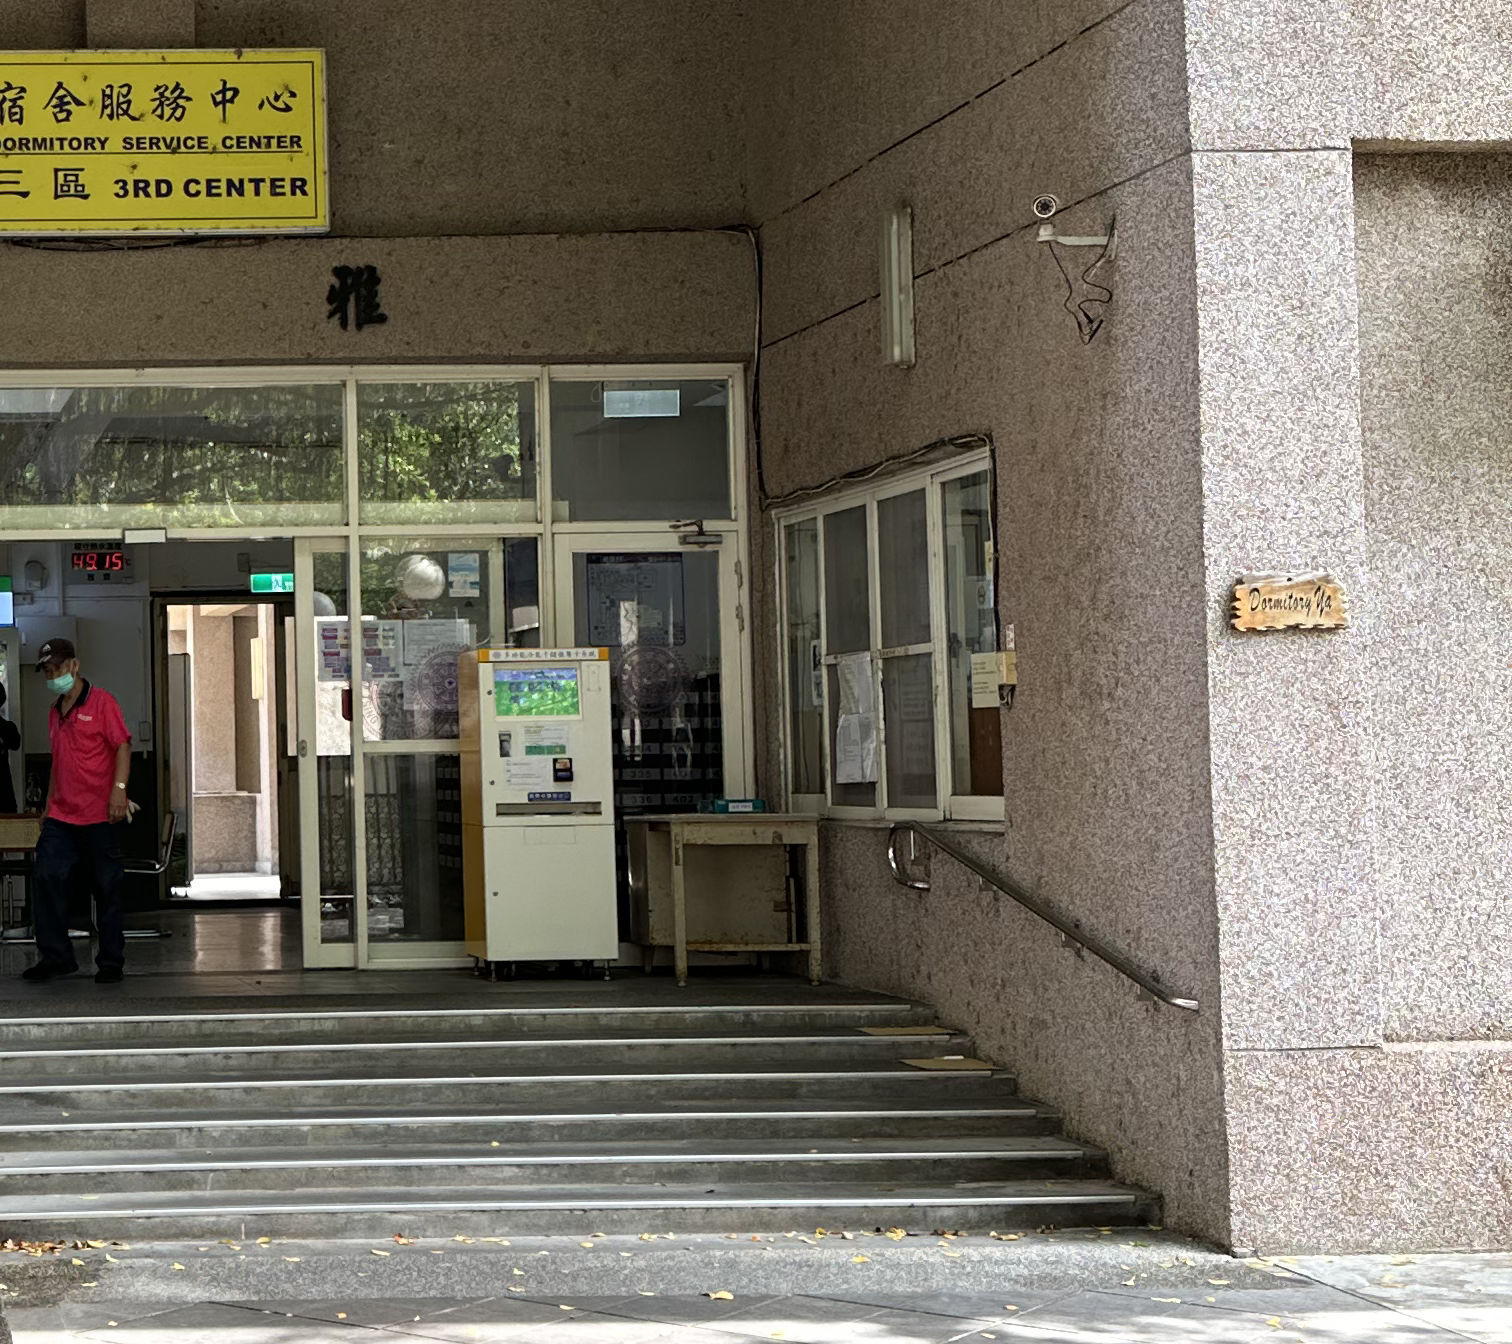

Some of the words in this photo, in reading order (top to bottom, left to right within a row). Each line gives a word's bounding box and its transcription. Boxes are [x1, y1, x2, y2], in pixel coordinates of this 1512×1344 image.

[122, 136, 209, 151] SERVICE
[221, 135, 303, 150] CENTER
[113, 178, 173, 199] 3RD
[183, 177, 309, 199] CENTER
[1249, 587, 1312, 616] Dormitory
[1314, 585, 1332, 617] Ya
